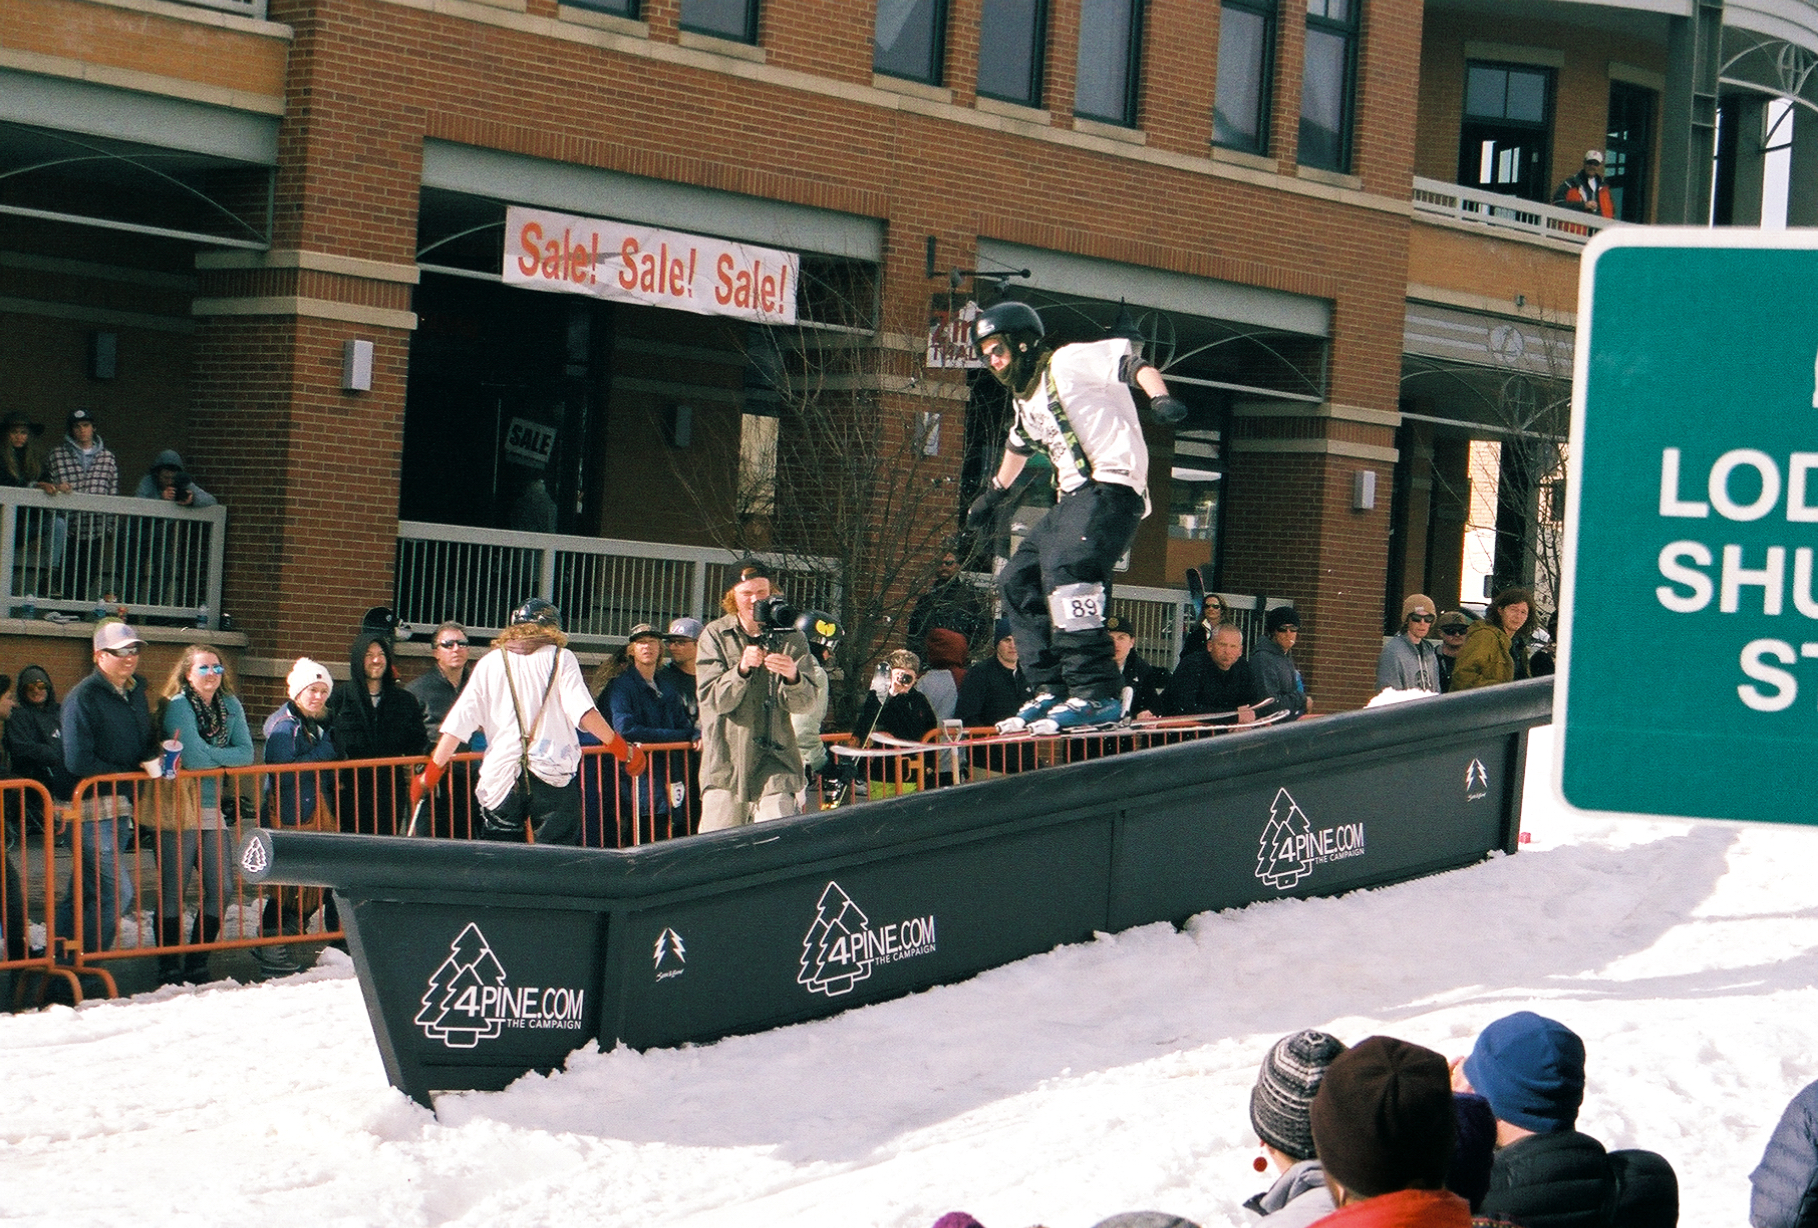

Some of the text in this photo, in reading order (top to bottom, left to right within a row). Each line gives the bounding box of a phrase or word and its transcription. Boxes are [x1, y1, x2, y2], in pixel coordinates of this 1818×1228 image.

[518, 222, 788, 314] Sale! Sale! Sale!
[508, 424, 553, 456] SALE
[1071, 598, 1098, 618] 89
[1278, 822, 1365, 863] 4PINE.COM
[1315, 848, 1365, 865] THE CAMPAIGN
[827, 914, 936, 965] 4PINE.COM
[875, 943, 937, 966] THE CAMPAIGN
[453, 985, 585, 1020] 4PINE.COM
[507, 1018, 582, 1030] THE CAMPAIGN
